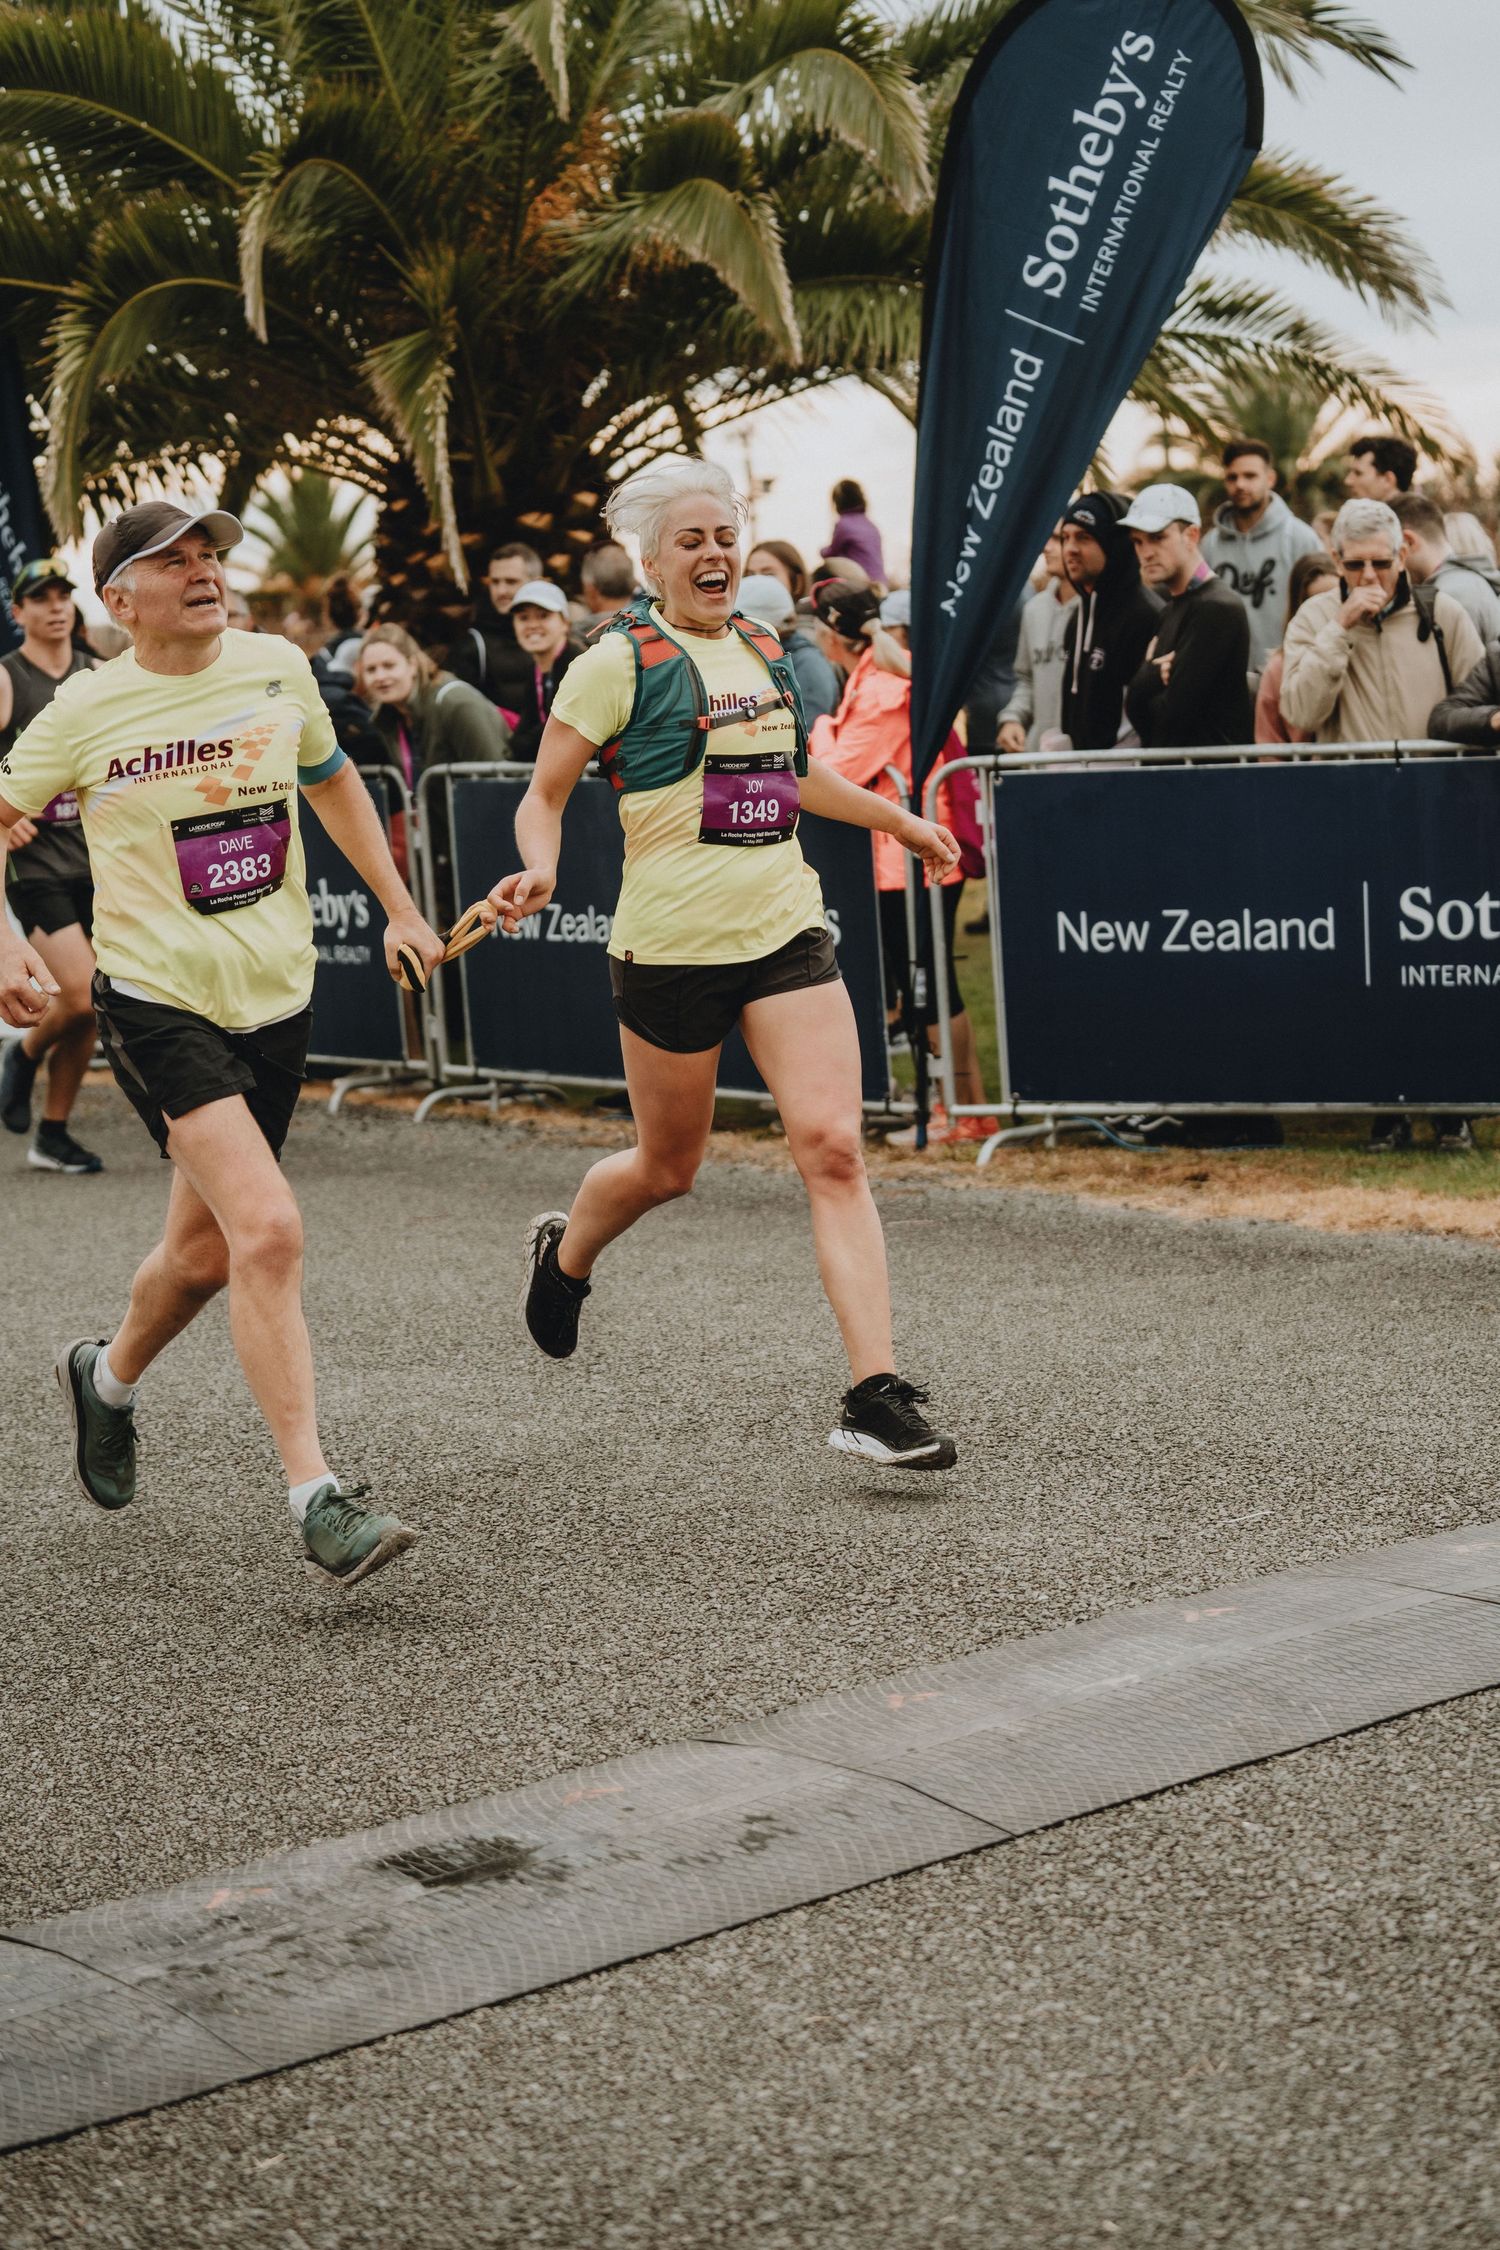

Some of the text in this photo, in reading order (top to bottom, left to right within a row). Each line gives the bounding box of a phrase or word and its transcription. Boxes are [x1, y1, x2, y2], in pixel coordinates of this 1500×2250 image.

[1022, 30, 1155, 298] Sotheby's
[1080, 49, 1193, 313] INTERNATIONAL REALTY
[967, 348, 1044, 520] Zealand
[709, 693, 758, 711] hilles
[105, 738, 233, 782] Achilles
[134, 760, 234, 784] INTERNATIONAL
[238, 785, 267, 797] New
[746, 780, 763, 794] JOY
[728, 799, 779, 824] 1349
[219, 835, 254, 855] DAVE
[207, 853, 272, 889] 2383
[309, 878, 370, 939] eby's
[546, 903, 613, 943] Zeala
[1057, 907, 1336, 953] New Zealand
